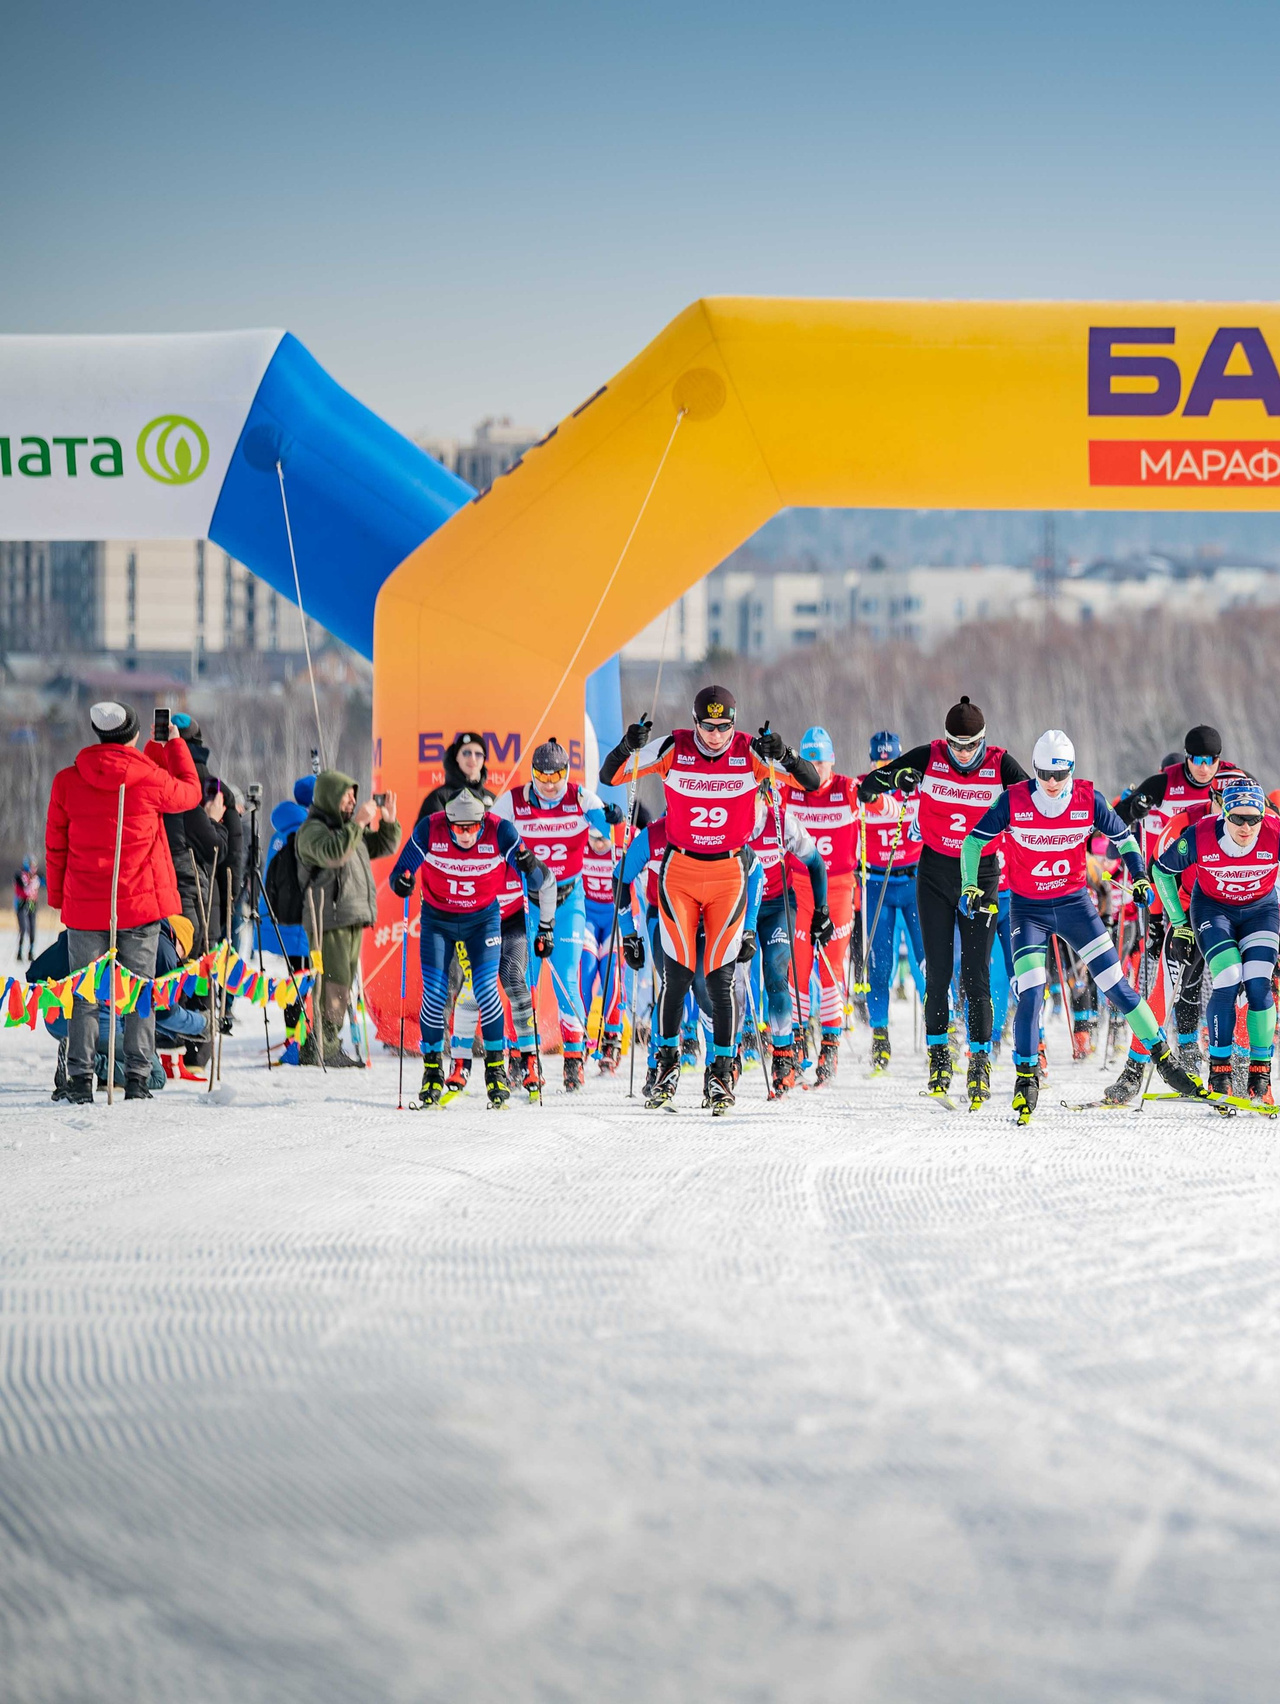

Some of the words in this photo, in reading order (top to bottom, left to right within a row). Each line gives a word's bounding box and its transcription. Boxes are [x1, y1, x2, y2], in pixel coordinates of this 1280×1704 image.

[418, 732, 521, 763] БМ
[679, 778, 744, 791] ТЕМЕРСО
[932, 783, 992, 800] ТЕМЕРСО
[690, 806, 728, 828] 29
[949, 813, 967, 832] 2
[877, 829, 904, 846] 12
[941, 836, 964, 845] ТЕМЕР
[1021, 833, 1083, 845] ТЕМЕРСО
[533, 844, 568, 861] 92
[1030, 860, 1071, 876] 40
[447, 879, 476, 896] 13
[455, 941, 473, 991] CRAFT
